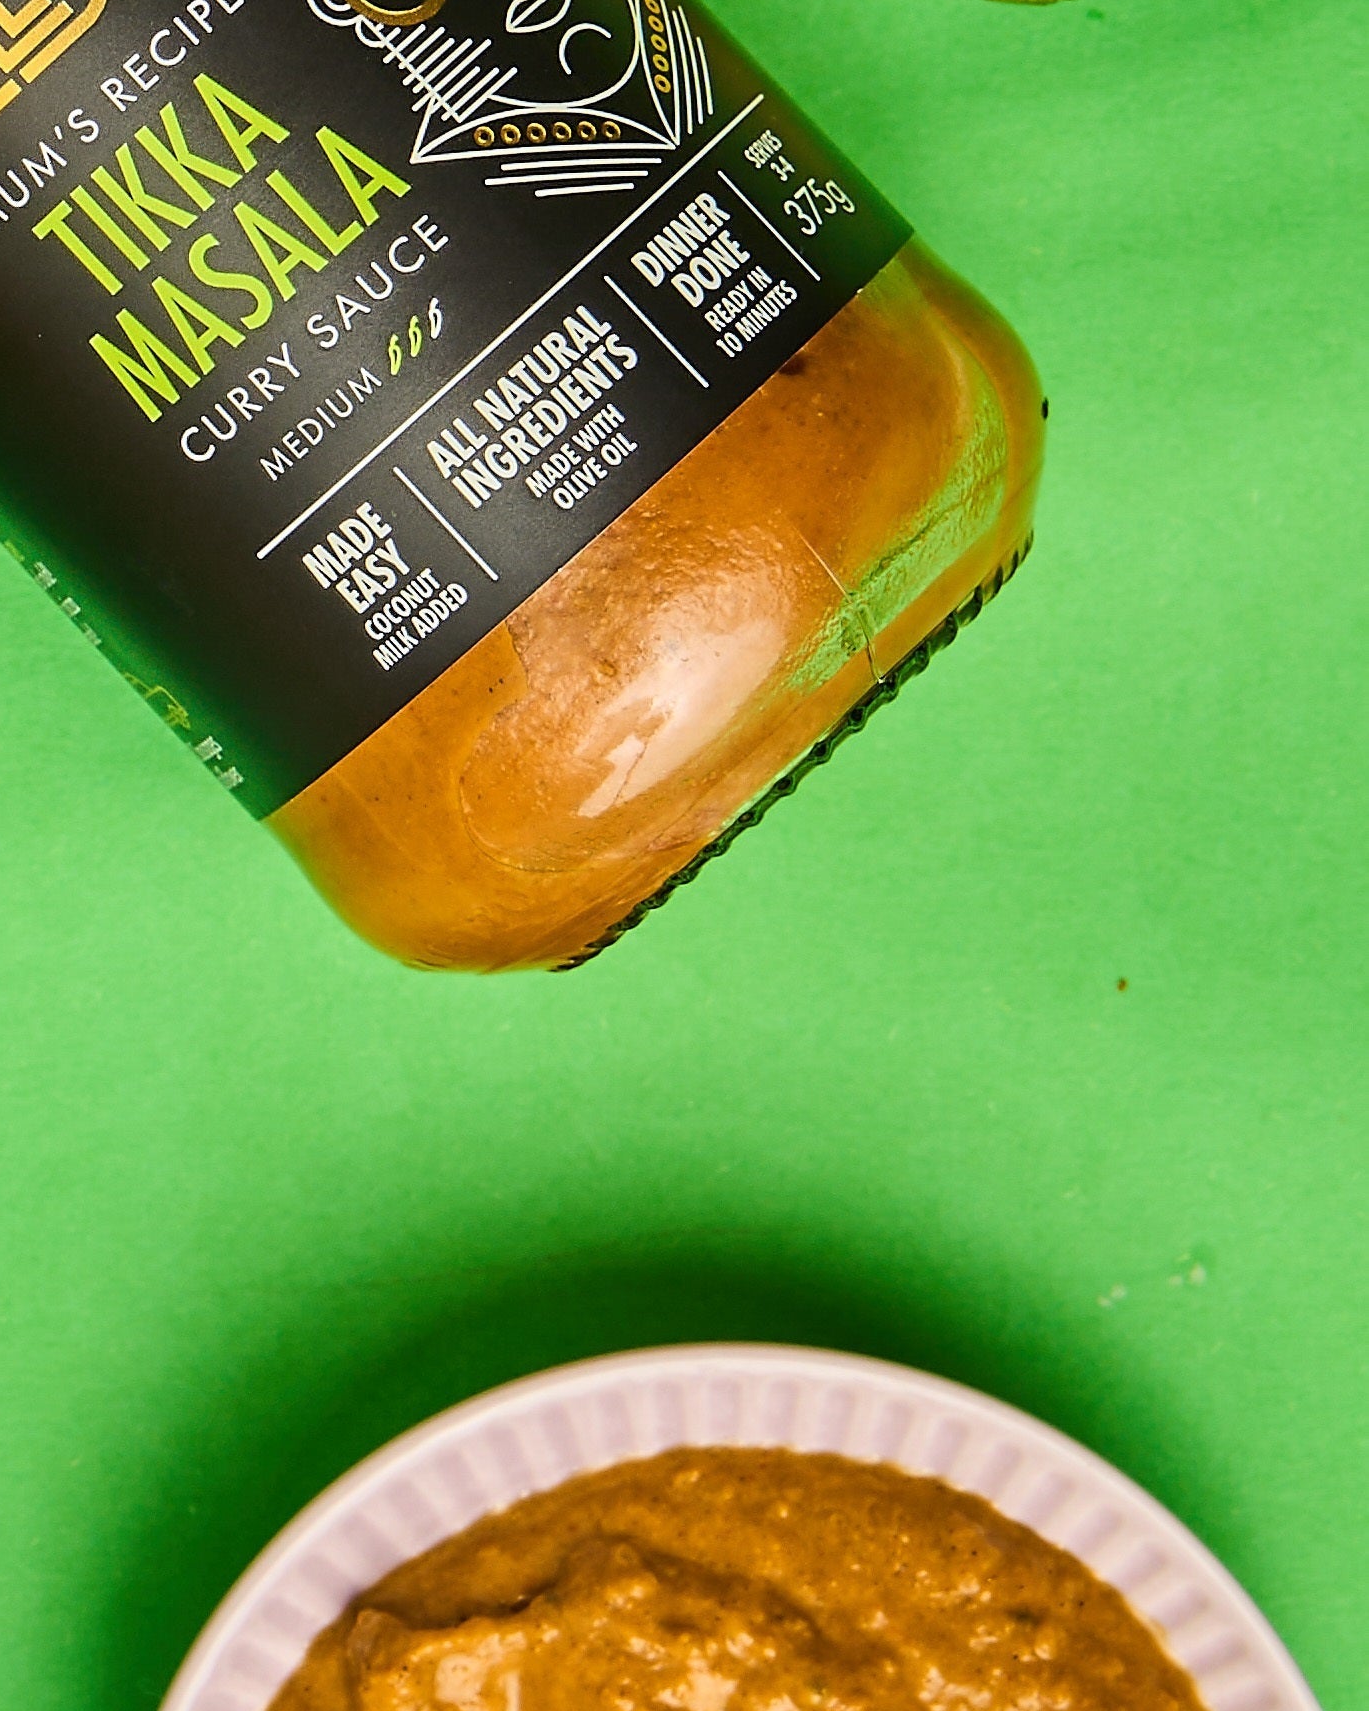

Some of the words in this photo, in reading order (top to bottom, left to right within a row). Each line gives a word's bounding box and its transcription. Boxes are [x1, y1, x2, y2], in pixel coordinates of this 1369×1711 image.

[32, 73, 290, 295] TIKKA
[744, 129, 783, 168] SERVES
[630, 193, 731, 287] DINNER
[783, 178, 855, 235] 375g
[89, 126, 412, 422] MASALA
[671, 230, 751, 307] DONE
[704, 280, 755, 332] READY
[747, 266, 773, 291] IN
[180, 342, 301, 462] CURRY
[307, 214, 449, 348] SAUCE
[716, 332, 743, 358] 10
[735, 280, 798, 342] MINUTES
[260, 367, 382, 481] MEDIUM
[427, 417, 488, 479] ALL
[472, 305, 612, 431] NATURAL
[451, 333, 638, 508] INGREDIENTS
[525, 443, 581, 498] MADE
[572, 403, 625, 452] WITH
[552, 457, 607, 510] OLIVE
[601, 433, 638, 466] OIL
[302, 501, 392, 589] MADE
[336, 539, 410, 614] EASY
[364, 567, 441, 641] COCONUT
[372, 624, 419, 671] MILK
[416, 583, 467, 638] ADDED
